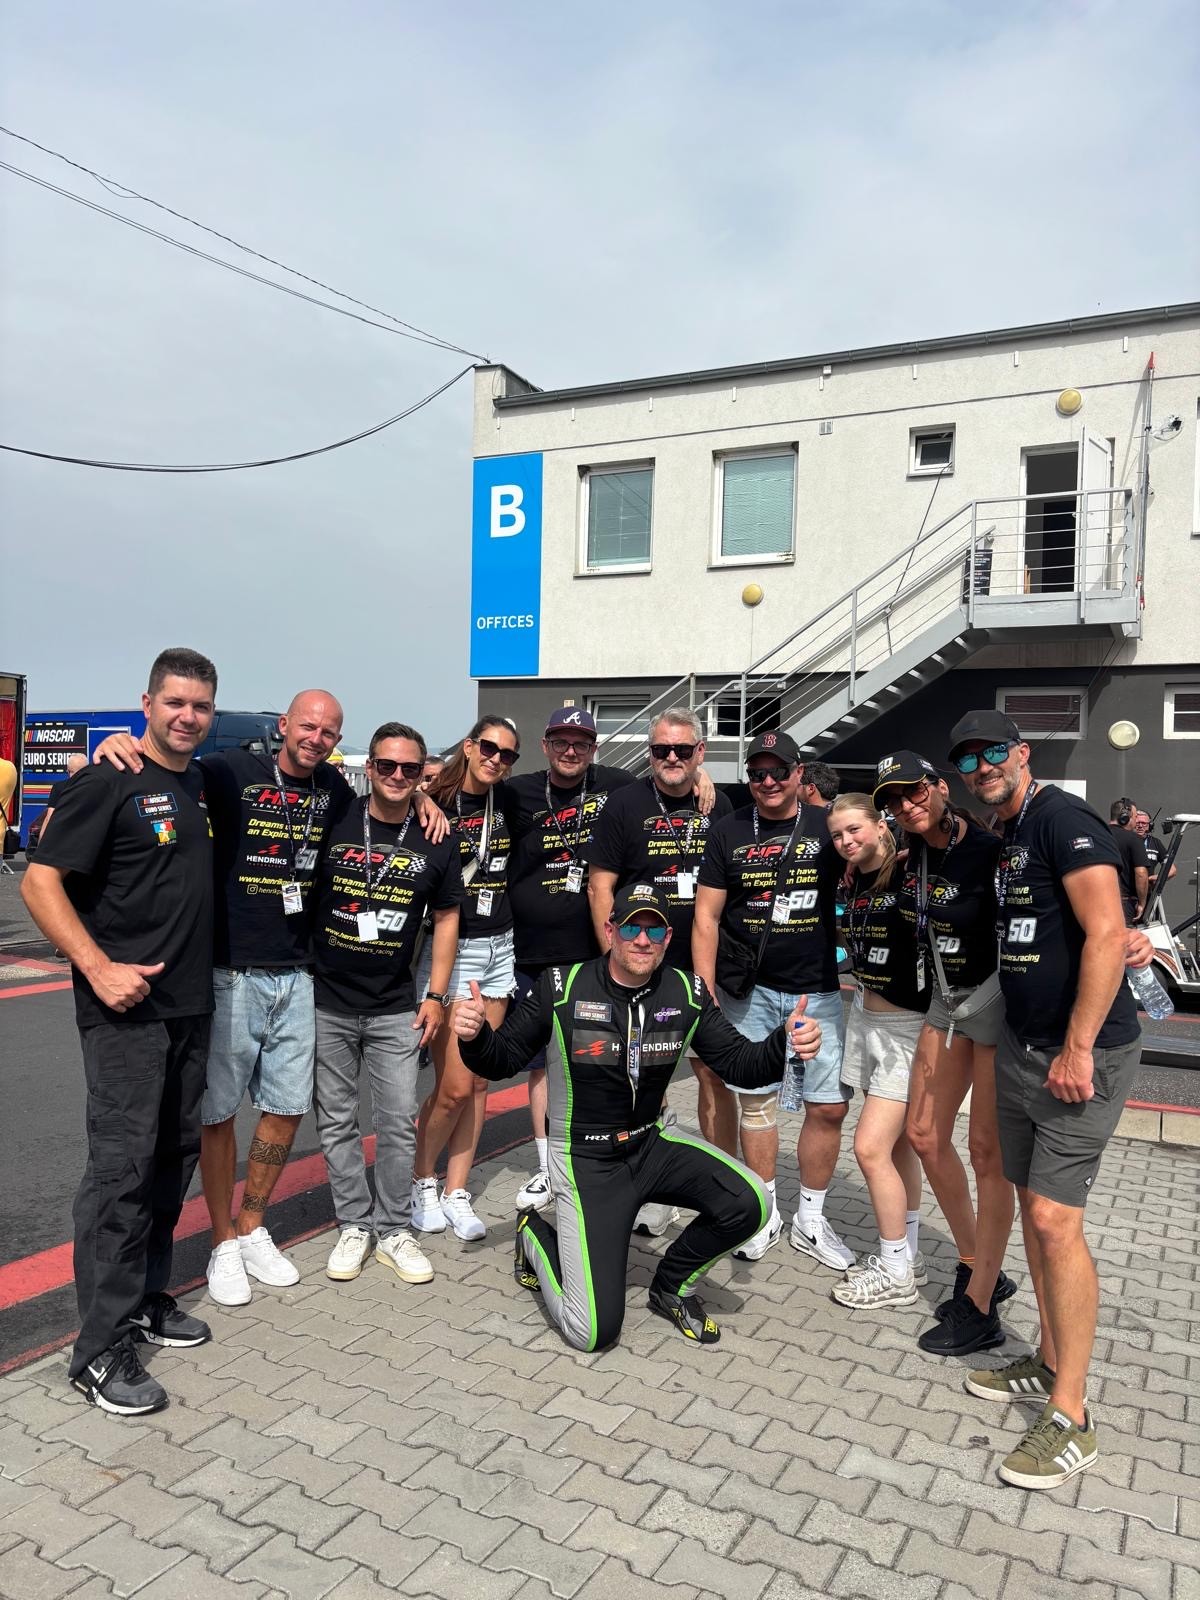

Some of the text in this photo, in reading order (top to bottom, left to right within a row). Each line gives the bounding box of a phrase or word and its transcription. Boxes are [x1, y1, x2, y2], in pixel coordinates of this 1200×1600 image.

[490, 484, 526, 538] B
[476, 614, 534, 630] OFFICES
[36, 729, 75, 742] NASCAR
[24, 752, 74, 766] EURO SERIE
[248, 818, 285, 829] Dreams
[246, 828, 260, 836] an
[261, 829, 304, 841] Expiraion
[648, 840, 677, 848] Dreams
[648, 848, 659, 856] an
[246, 855, 288, 865] HENDRIKS
[741, 871, 772, 880] Dreams
[796, 868, 818, 877] have
[796, 874, 819, 885] Date!
[333, 875, 368, 888] Dreams
[392, 886, 415, 897] have
[633, 884, 654, 896] 50
[332, 884, 342, 892] an
[389, 892, 413, 905] Date!
[789, 889, 818, 912] 50
[332, 908, 359, 922] HENDRI
[376, 908, 409, 932] 50
[1008, 917, 1038, 943] 50
[867, 946, 890, 966] 50
